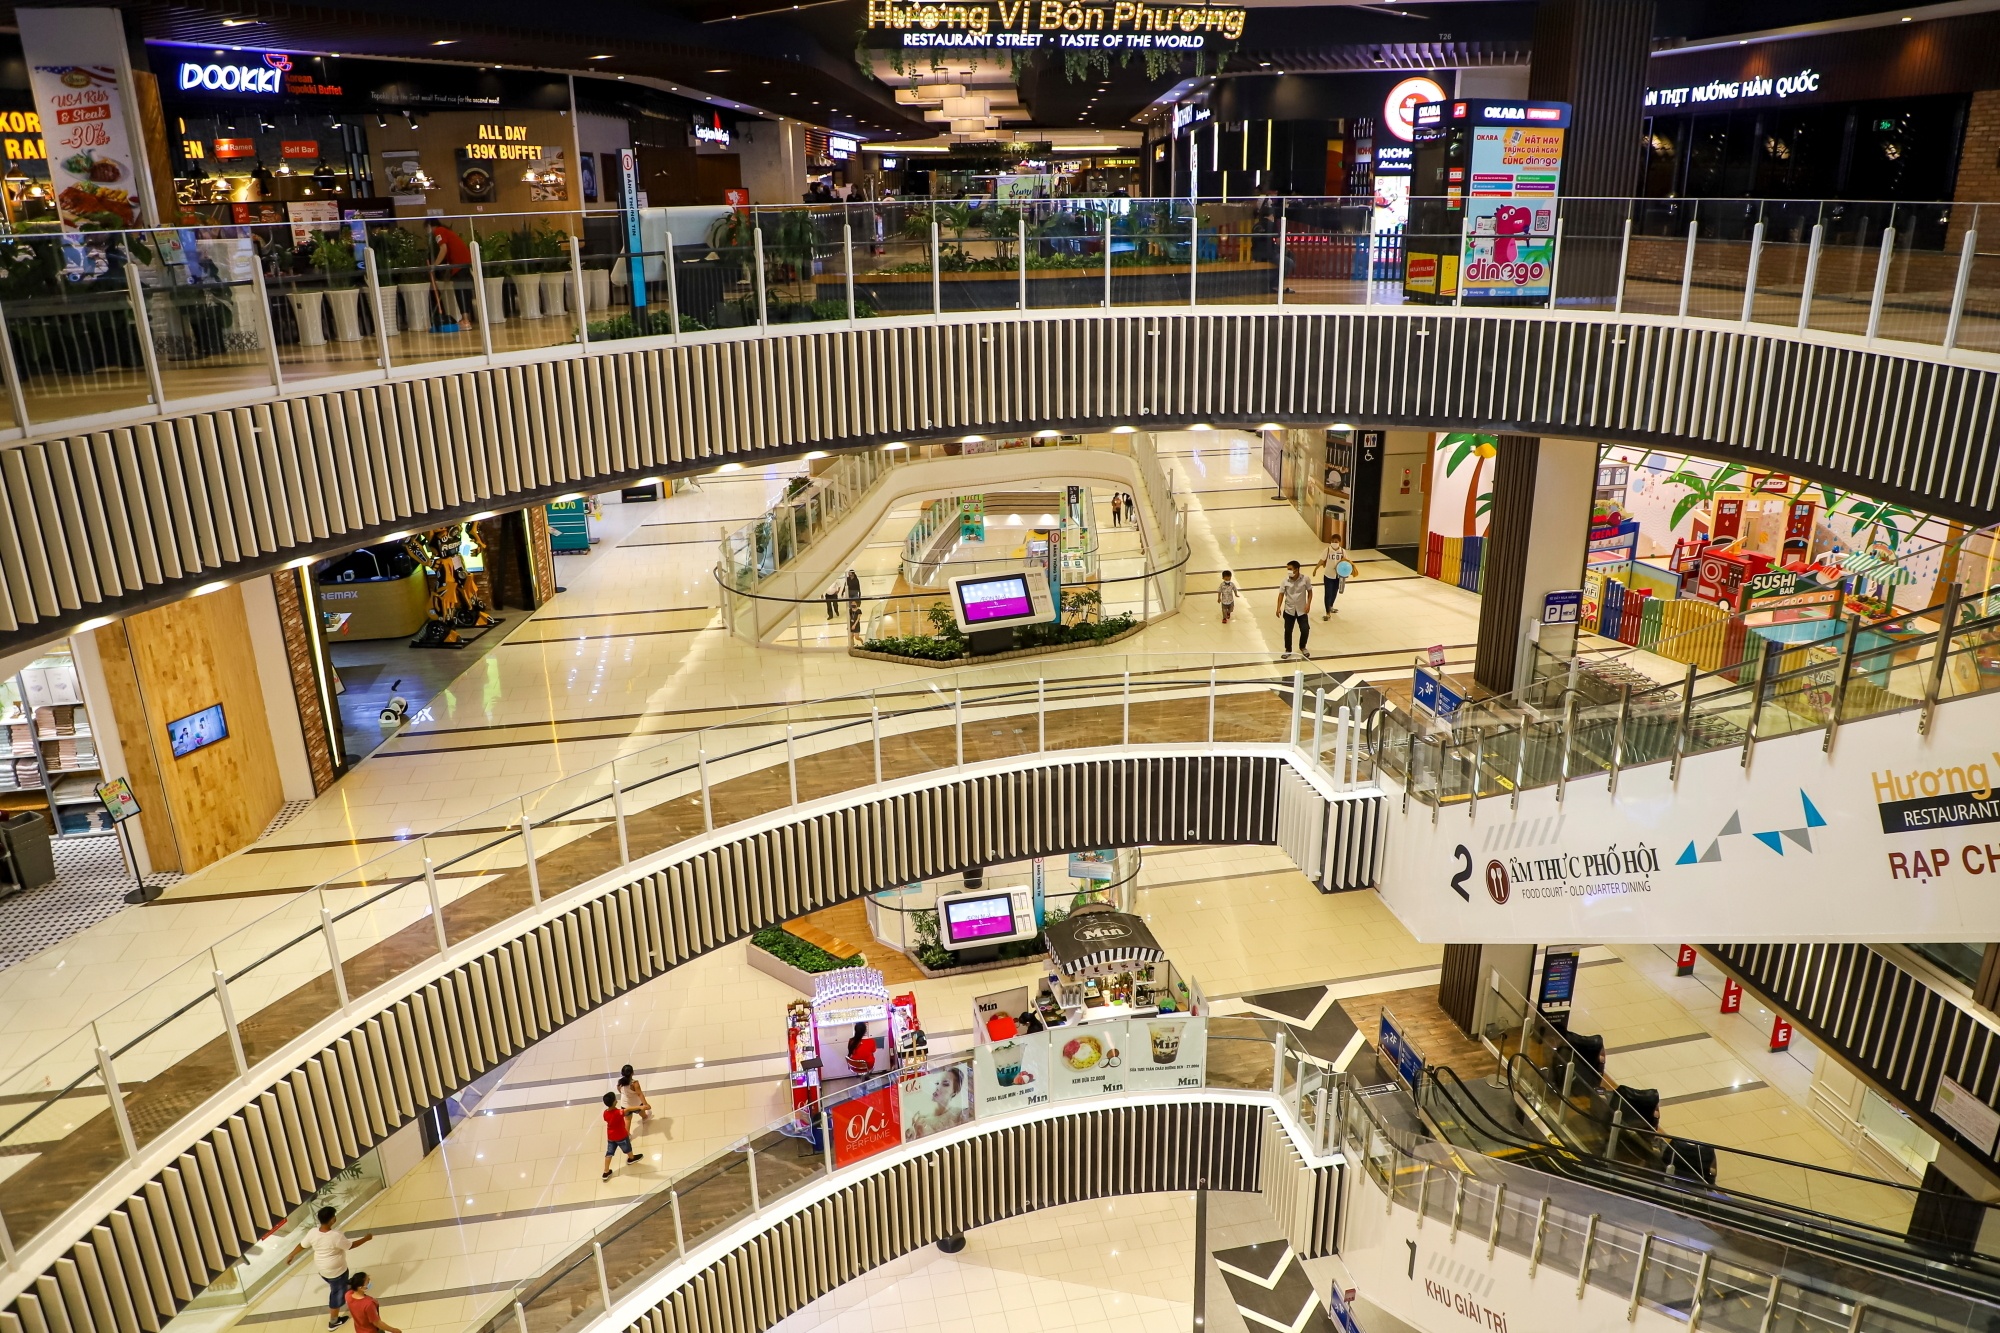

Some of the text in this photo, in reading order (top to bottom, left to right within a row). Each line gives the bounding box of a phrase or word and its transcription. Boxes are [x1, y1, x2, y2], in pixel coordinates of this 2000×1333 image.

[868, 0, 989, 36] Hương
[998, 0, 1031, 34] Vị
[1112, 1, 1246, 40] Phương
[904, 33, 1204, 48] RESTAURANT STREET TASTE OF THE WORLD
[180, 63, 282, 93] DOOKKI
[286, 74, 313, 83] Korean
[318, 85, 343, 95] Buffet
[1660, 88, 1689, 107] THỊT
[1691, 80, 1739, 103] NƯỚNG
[1741, 75, 1772, 97] HÀN
[1775, 69, 1819, 98] QUỐC
[51, 90, 109, 107] USA Ribs
[61, 107, 106, 121] & Steak
[1484, 107, 1525, 119] OKARA
[479, 125, 527, 141] ALL DAY
[466, 144, 542, 160] 139K BUFFET
[1466, 258, 1544, 285] dinogo
[1590, 527, 1619, 540] CREAM
[1752, 573, 1797, 590] SUSHI
[320, 590, 358, 600] REMAX
[1549, 608, 1557, 619] P
[1425, 682, 1434, 695] 3F
[1871, 763, 1992, 803] Hương
[1903, 800, 1999, 827] RESTAURANT
[1510, 842, 1660, 885] ẨM THỰC PHỐ HỘI
[1888, 848, 1950, 884] RẠP
[1451, 844, 1473, 903] 2
[1522, 888, 1540, 899] FOOD
[1541, 886, 1563, 898] COURT
[1569, 884, 1585, 896] OLD
[1586, 883, 1620, 895] QUARTER
[1621, 880, 1651, 894] DINING
[1083, 927, 1125, 940] Min
[979, 1002, 998, 1012] Min
[1153, 1040, 1179, 1049] Min
[1390, 1032, 1398, 1044] 2F
[996, 1066, 1018, 1074] Min
[905, 1080, 922, 1092] Ohi
[1102, 1083, 1123, 1092] Min
[1178, 1077, 1198, 1086] Min
[1027, 1095, 1048, 1105] Min
[845, 1106, 889, 1143] Ohi
[846, 1130, 891, 1152] PERFUME
[1406, 1238, 1417, 1281] 1
[1424, 1278, 1508, 1333] KHU GIẢI TRÍ
